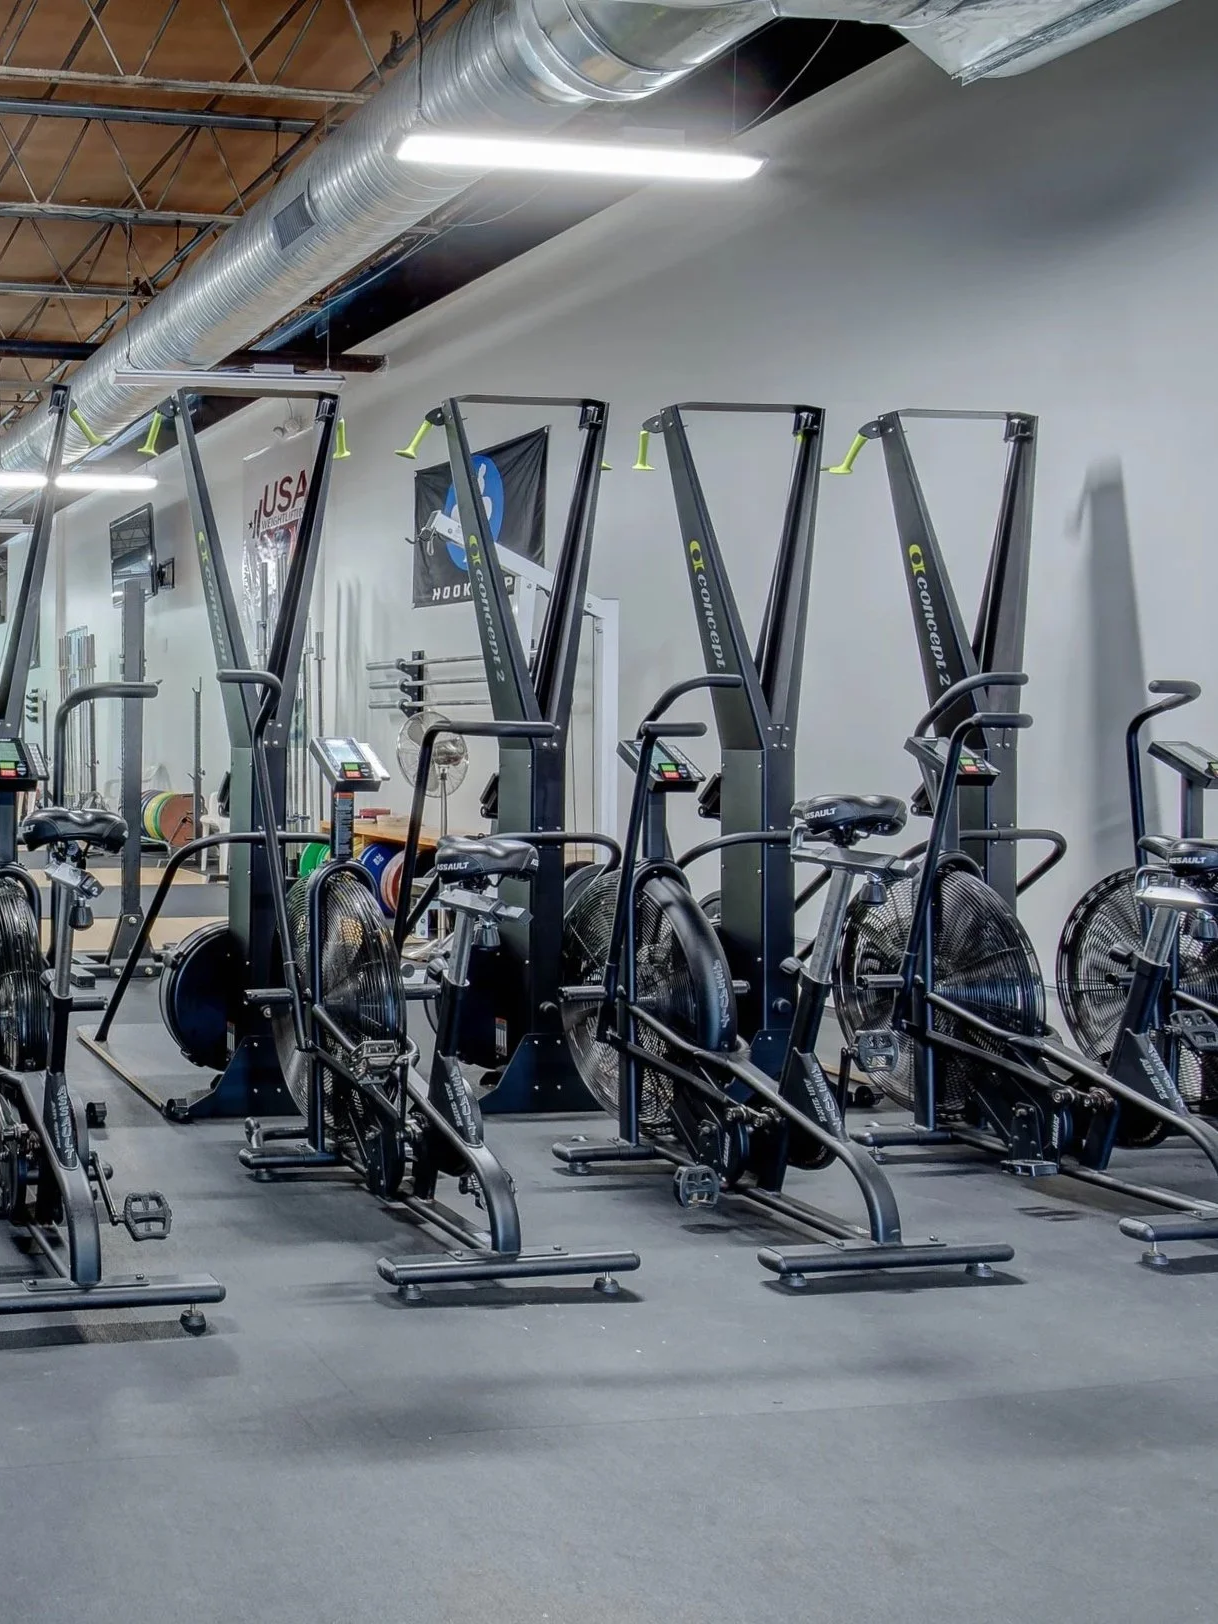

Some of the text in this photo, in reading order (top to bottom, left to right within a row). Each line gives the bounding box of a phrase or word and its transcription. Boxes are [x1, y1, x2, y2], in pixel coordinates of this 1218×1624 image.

[262, 507, 304, 530] WEIGHTLIFTI
[263, 469, 308, 518] USA
[205, 565, 227, 662] concept
[476, 568, 505, 682] concept 2
[697, 574, 726, 669] concept
[917, 576, 951, 687] concept 2
[92, 886, 99, 895] 2
[450, 1065, 477, 1136] ASSAULT
[803, 1079, 816, 1096] AIR
[811, 1062, 842, 1132] ASSAULT
[1139, 1058, 1155, 1075] AIR
[57, 1084, 75, 1160] ASSAULT
